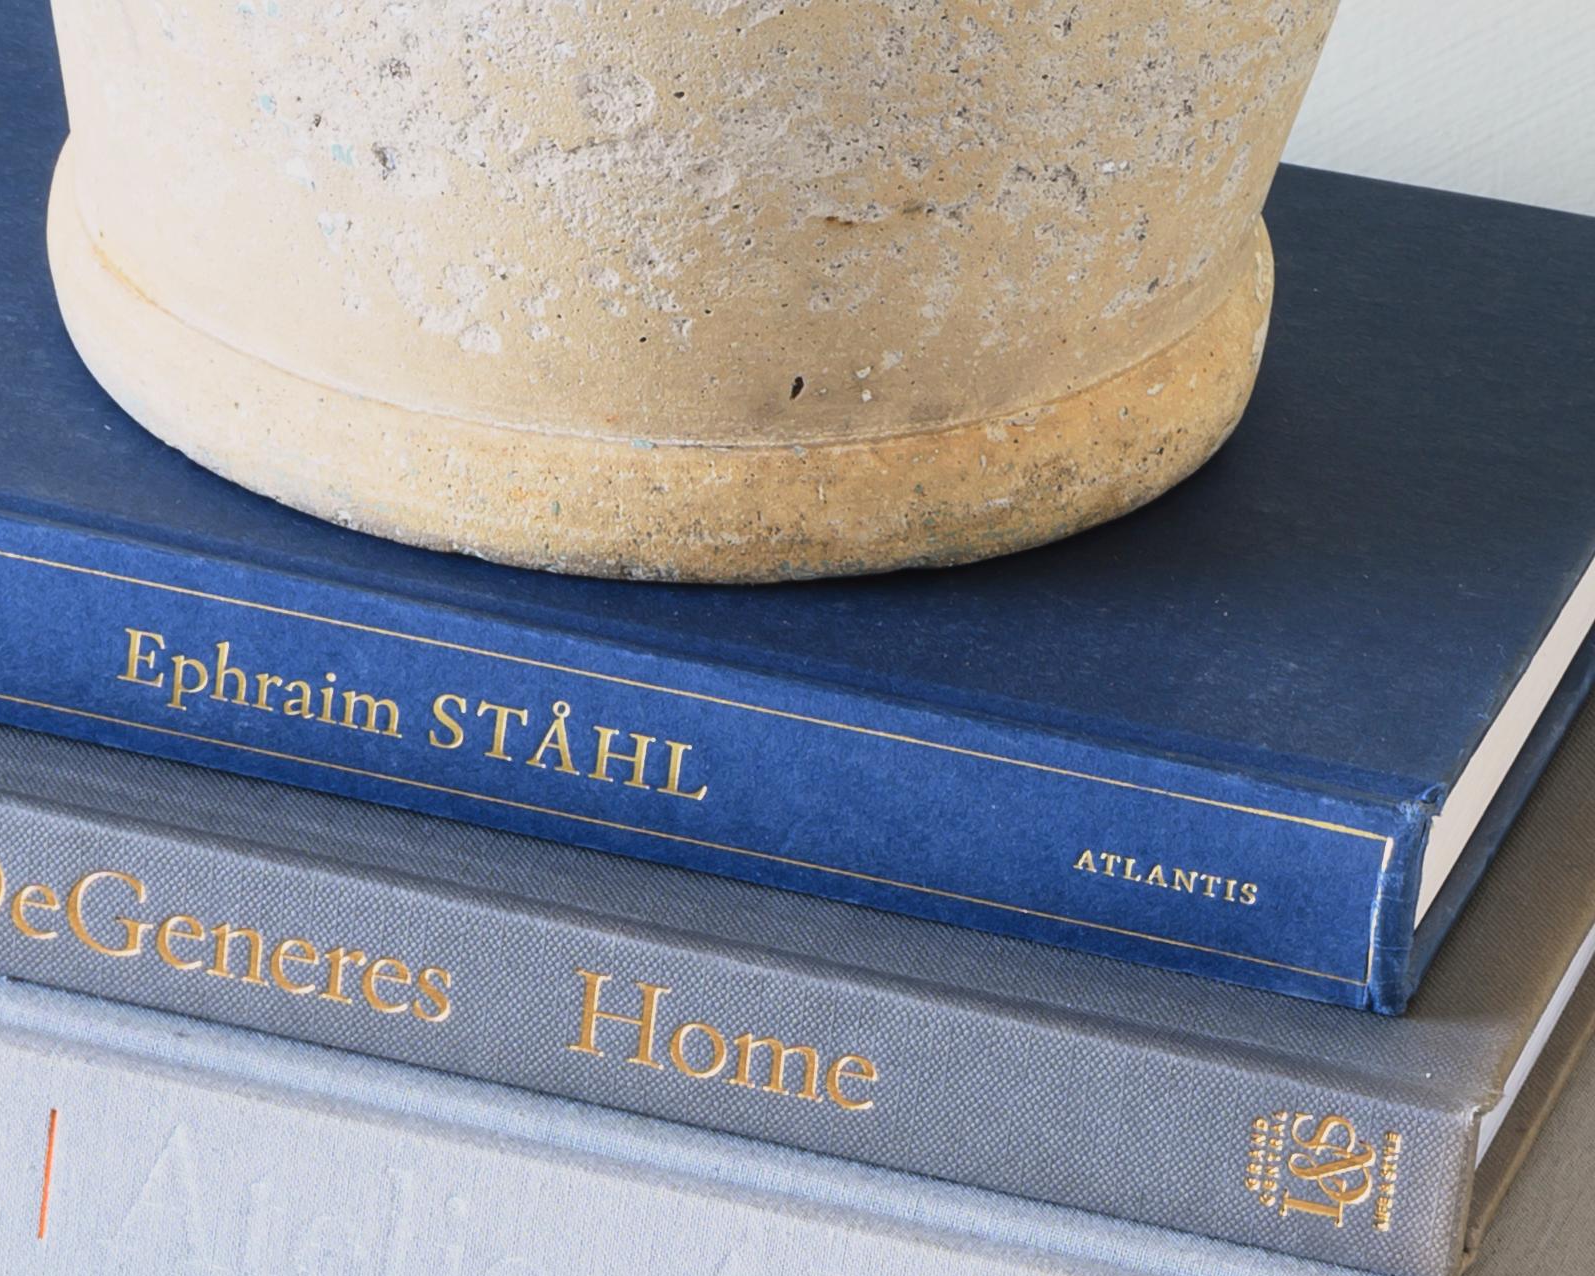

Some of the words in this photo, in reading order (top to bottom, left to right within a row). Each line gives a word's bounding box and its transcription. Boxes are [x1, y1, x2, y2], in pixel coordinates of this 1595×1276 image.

[116, 628, 403, 738] Ephraim
[427, 694, 708, 800] STÅHL
[1073, 849, 1260, 905] ATLANTIS
[565, 967, 878, 1110] Home
[1246, 1118, 1269, 1191] GRAND
[1259, 1110, 1288, 1207] CENTRAL
